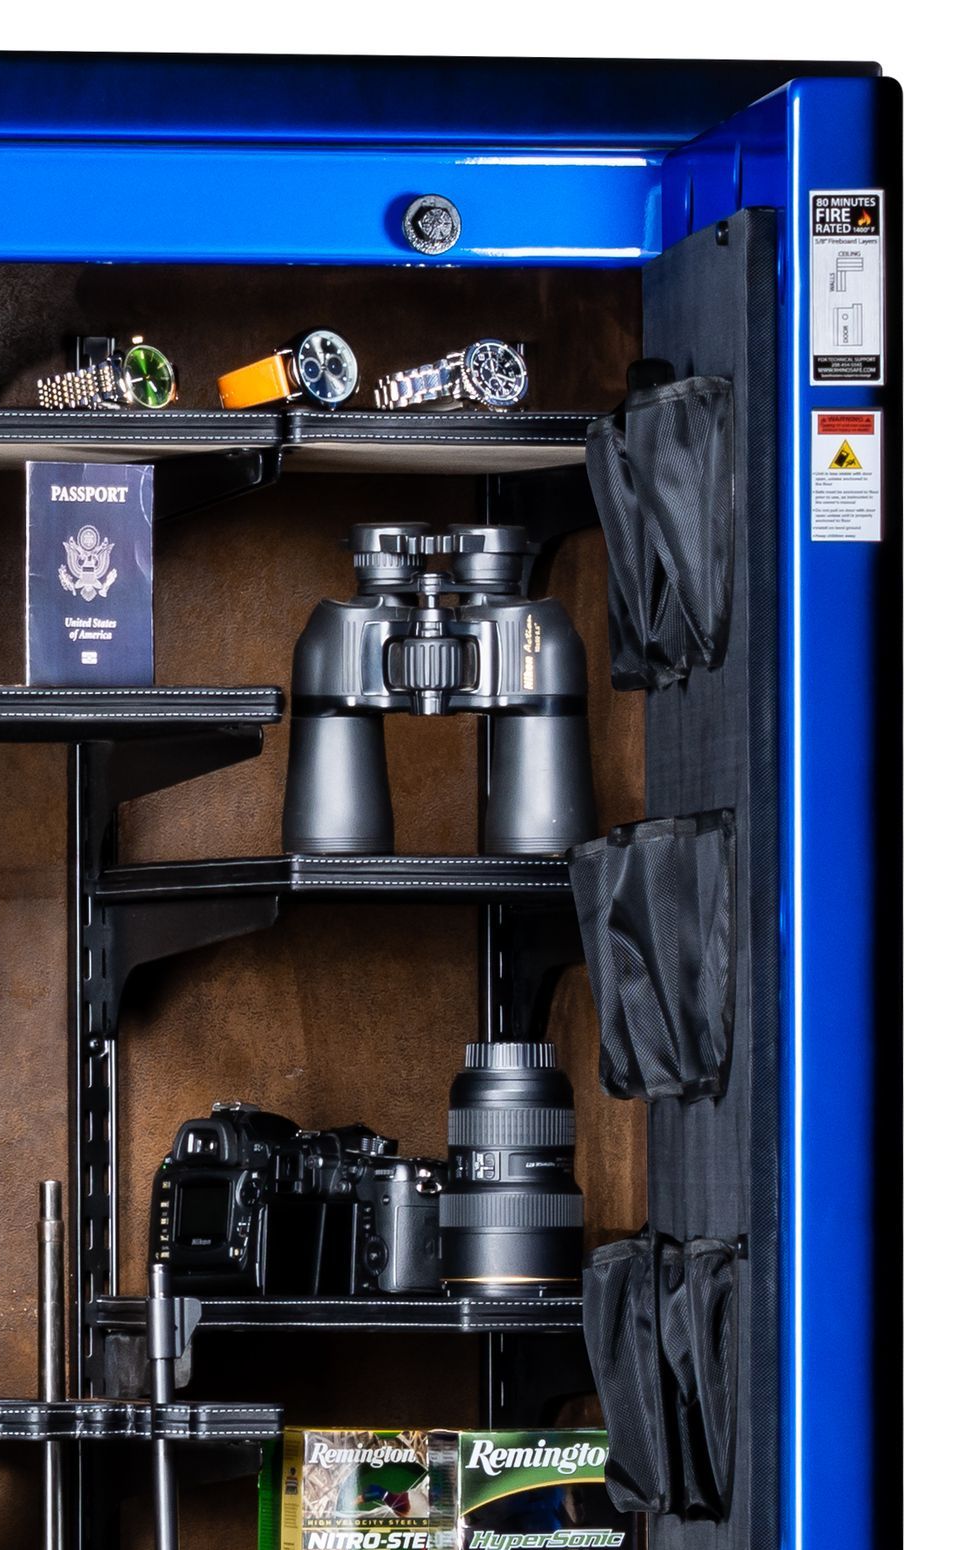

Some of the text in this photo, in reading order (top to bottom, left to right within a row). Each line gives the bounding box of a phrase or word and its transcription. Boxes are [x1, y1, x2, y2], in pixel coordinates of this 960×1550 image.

[816, 198, 876, 207] 80 MINUTES
[816, 208, 851, 222] FIRE
[815, 224, 851, 233] RATED
[51, 486, 128, 502] PASSPORT
[65, 617, 117, 629] United States
[69, 629, 112, 641] of America
[523, 614, 534, 690] Nikon Action
[309, 1443, 417, 1468] Remington
[465, 1439, 609, 1476] Remingto
